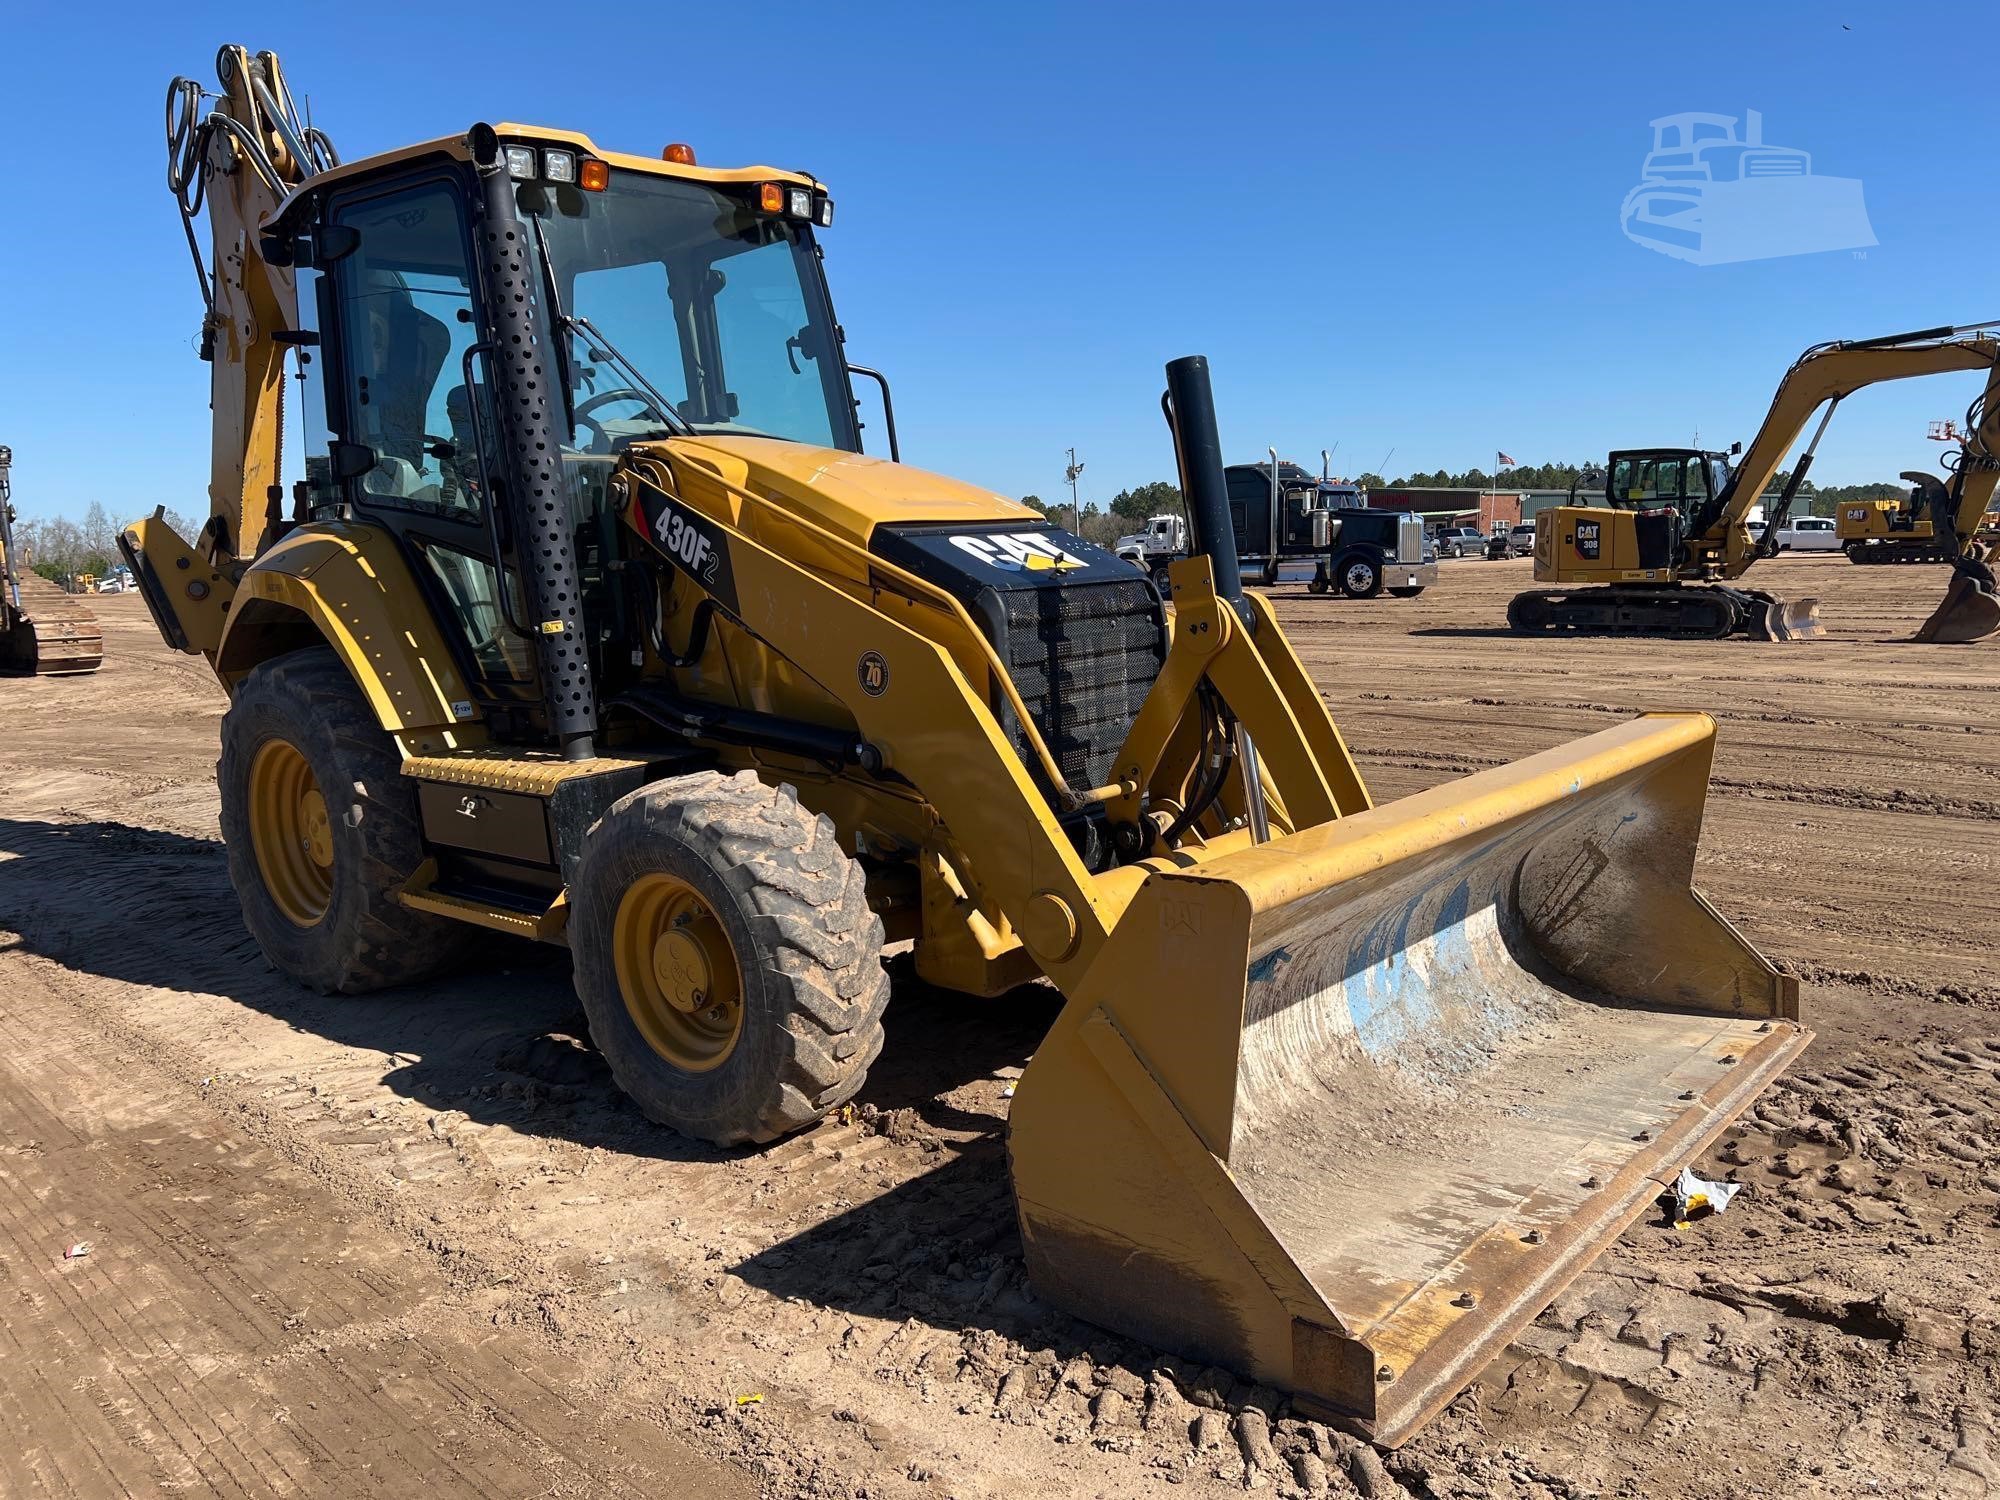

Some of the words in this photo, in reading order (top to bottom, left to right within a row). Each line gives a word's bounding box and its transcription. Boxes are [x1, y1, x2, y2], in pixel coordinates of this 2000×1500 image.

[1847, 509, 1865, 520] CAT
[1577, 525, 1599, 539] CAT
[949, 532, 1091, 572] CAT
